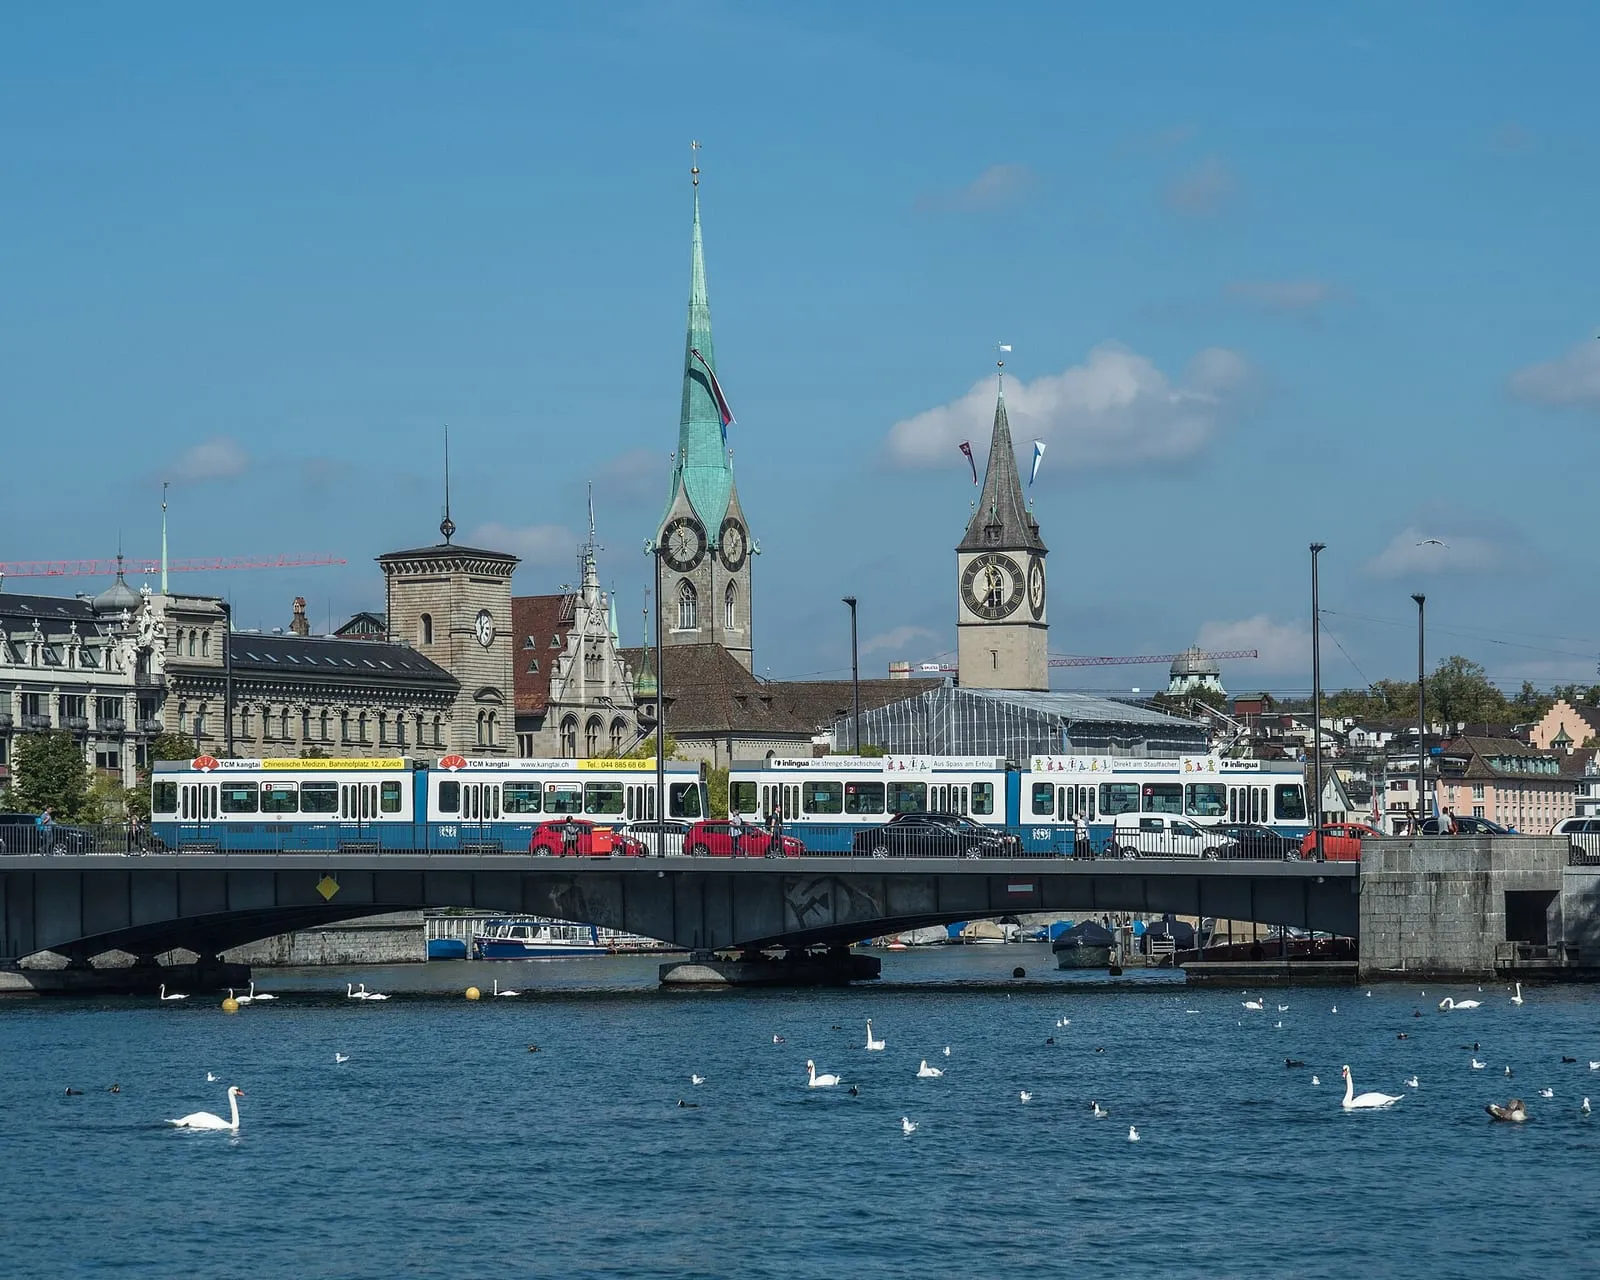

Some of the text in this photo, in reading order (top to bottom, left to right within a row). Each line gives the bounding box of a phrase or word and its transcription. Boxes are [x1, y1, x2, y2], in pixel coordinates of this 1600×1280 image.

[236, 761, 260, 769] kangtai
[302, 761, 328, 769] Medizin,
[329, 761, 369, 769] Bahnhofplatz
[382, 760, 402, 768] Zürich
[485, 761, 510, 769] kangtai
[520, 761, 569, 769] www.kangtai.ch
[782, 760, 810, 768] inlingua
[821, 760, 843, 768] strenge
[843, 760, 882, 768] Sprachschule
[1230, 760, 1258, 769] inlingua
